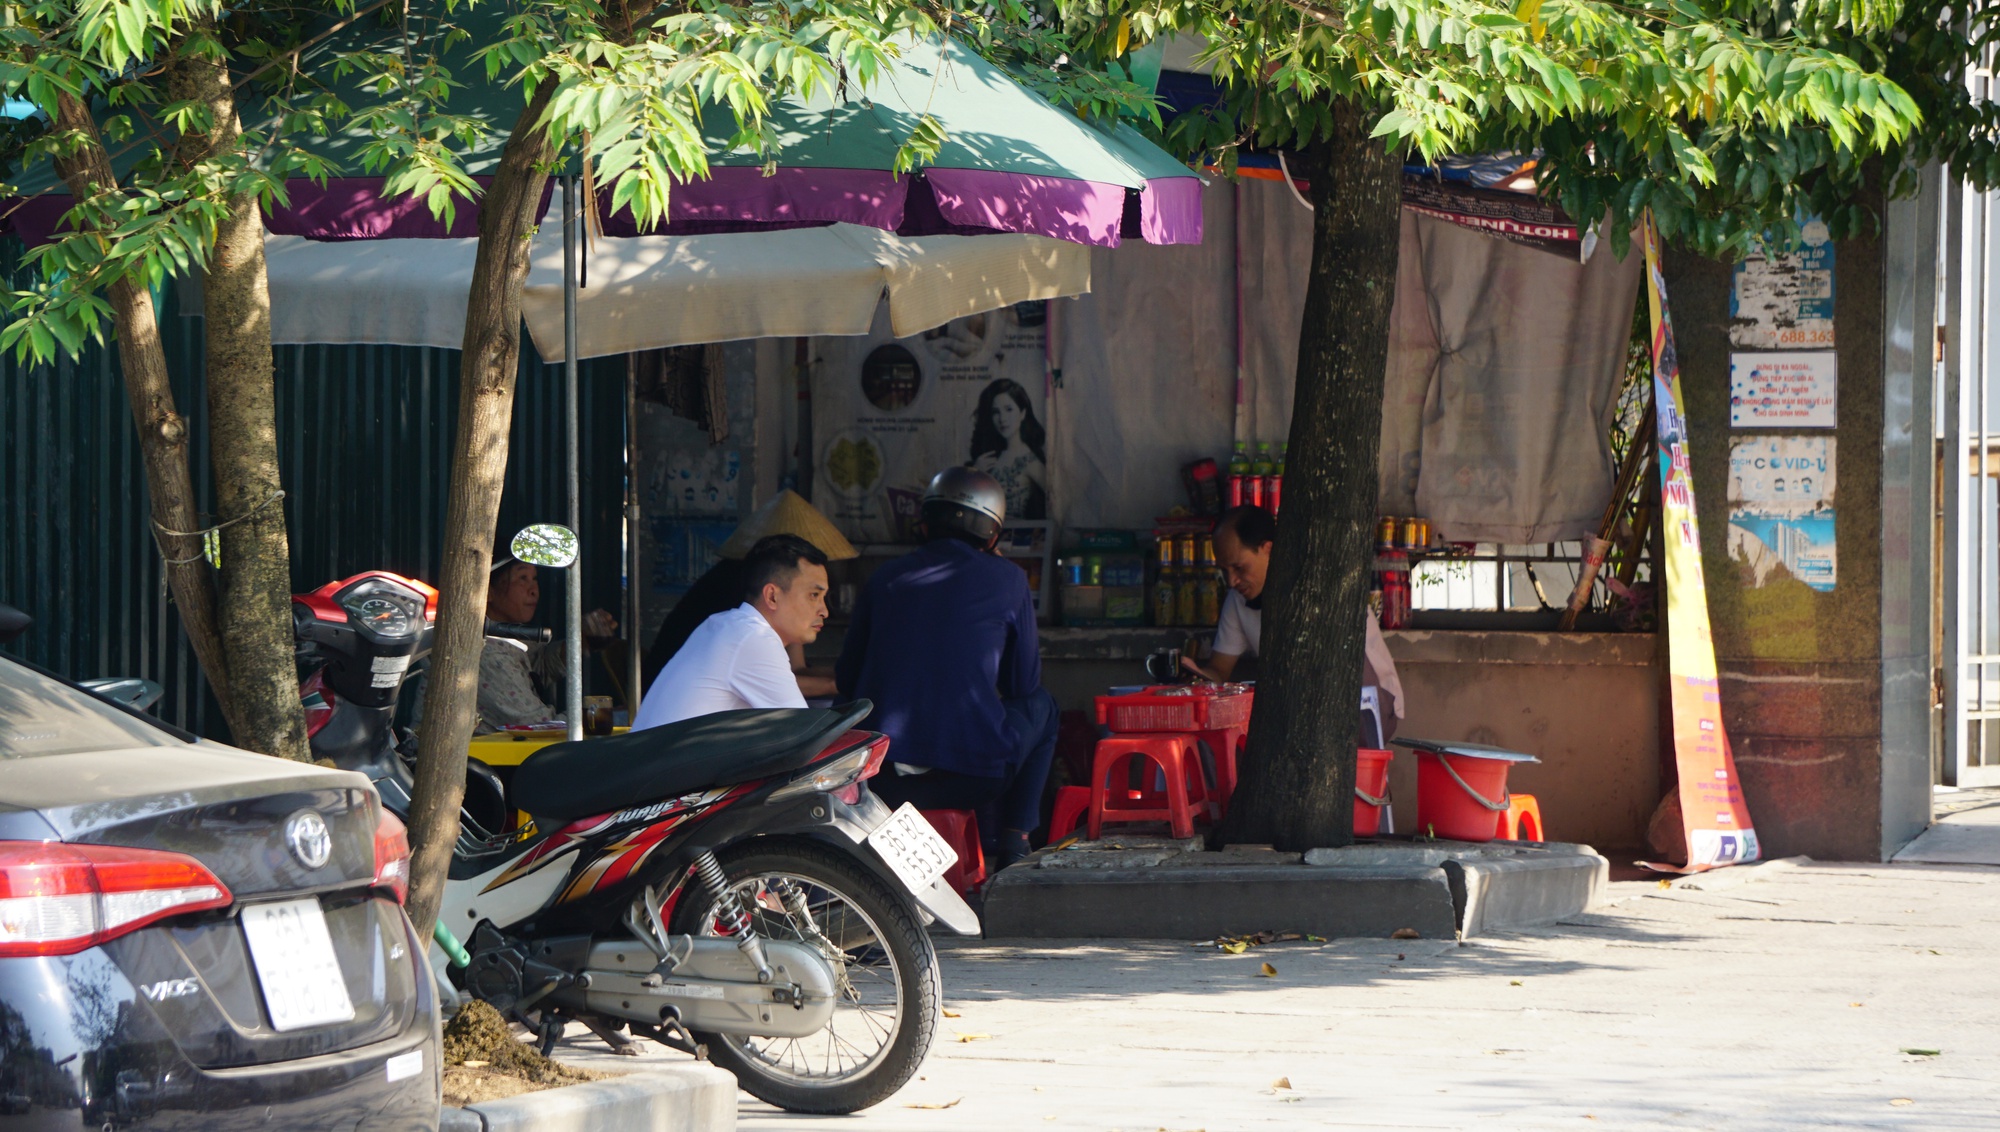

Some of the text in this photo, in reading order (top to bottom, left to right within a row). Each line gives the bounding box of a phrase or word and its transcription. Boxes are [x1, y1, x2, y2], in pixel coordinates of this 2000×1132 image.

[1459, 215, 1569, 239] HOTLINE:
[1780, 330, 1835, 343] 688.363
[140, 976, 200, 1003] VIOS
